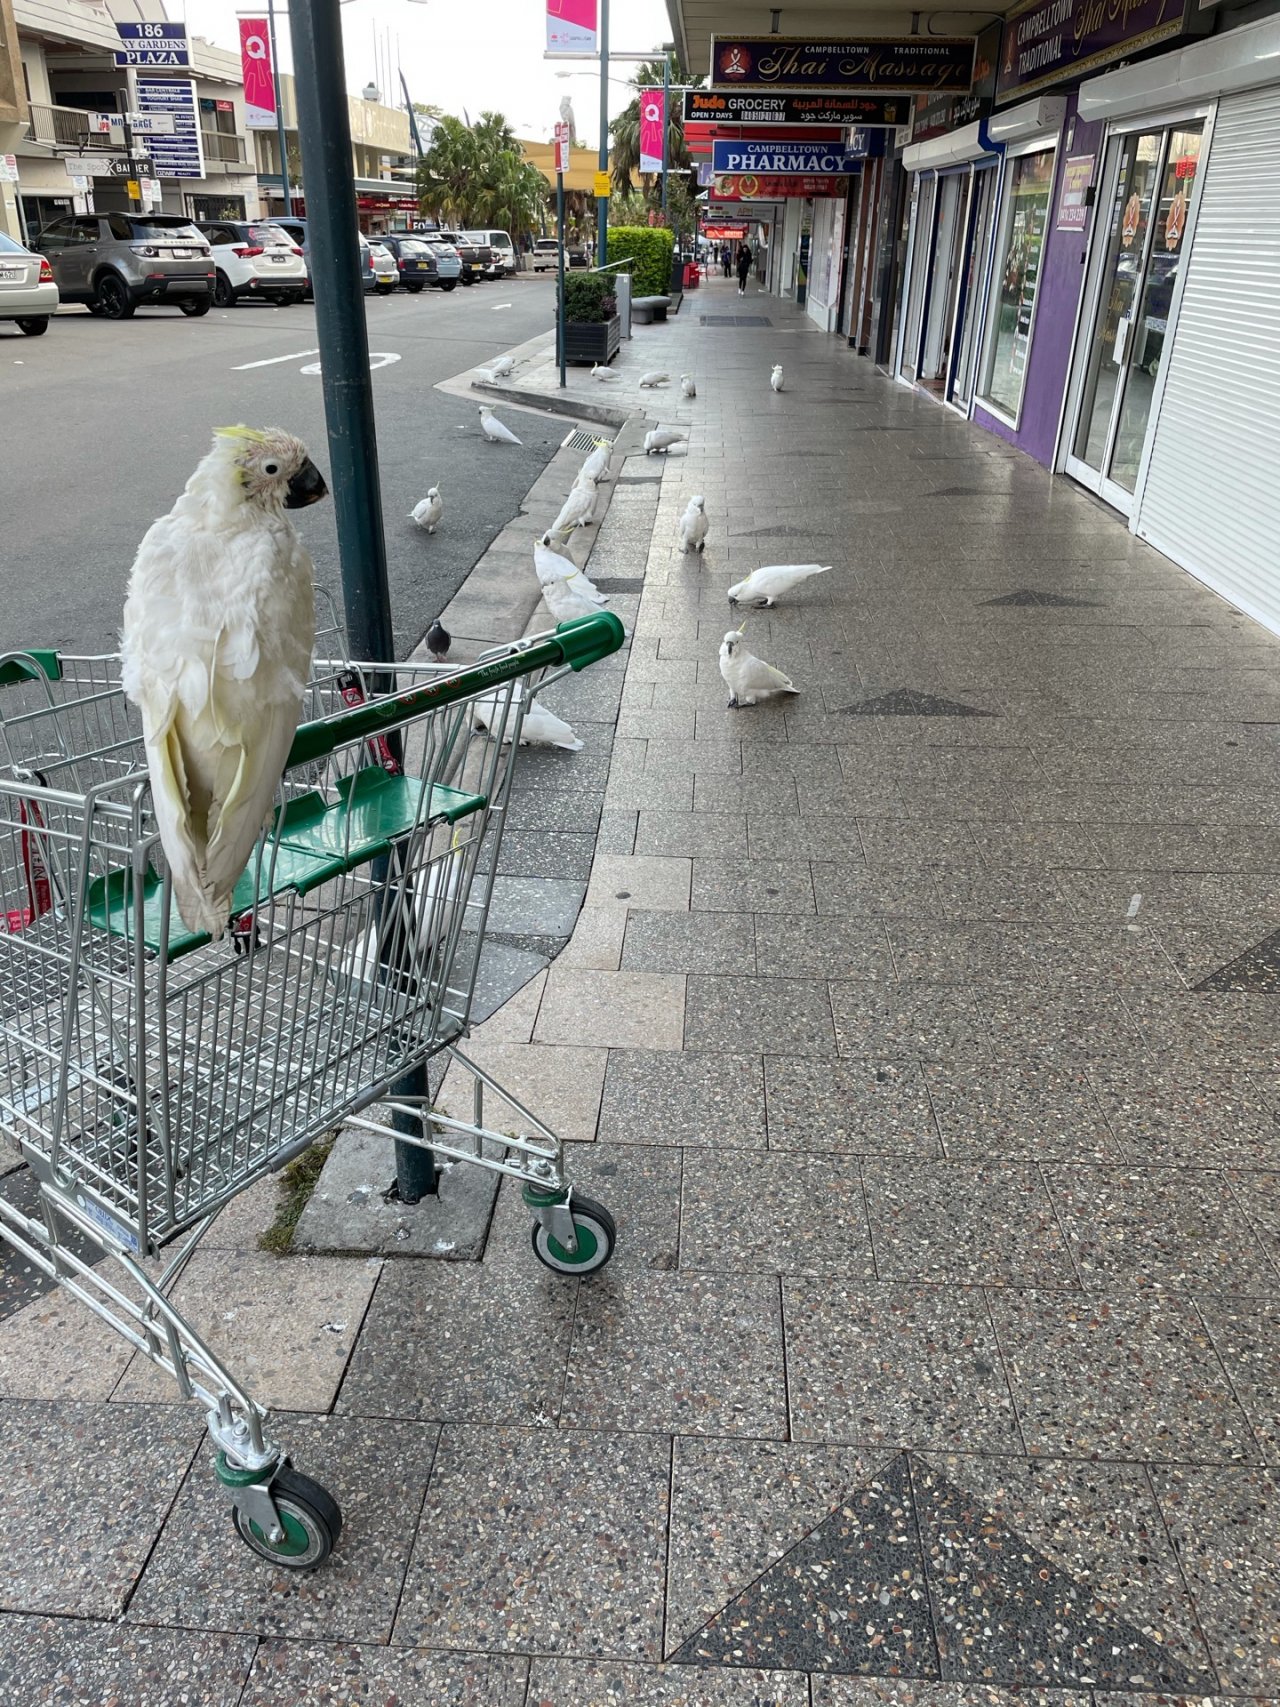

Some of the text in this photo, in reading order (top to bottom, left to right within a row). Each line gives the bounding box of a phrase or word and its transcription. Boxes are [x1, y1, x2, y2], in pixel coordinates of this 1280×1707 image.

[1017, 0, 1073, 46] CAMPBELLTOWN
[135, 23, 163, 38] 186
[138, 40, 186, 49] GARDENS
[804, 46, 950, 55] CAMPBELLTOWN TRADITIONAL
[125, 51, 180, 65] PLAZA
[1017, 34, 1062, 77] TRADITIONAL
[757, 46, 829, 82] Thai
[838, 51, 967, 87] Massage
[692, 94, 786, 110] Jude GROCERY
[709, 111, 715, 119] 7
[715, 111, 733, 119] DAYS
[111, 117, 153, 129] MOGAGE
[747, 144, 829, 154] CAMPBELLTOWN
[116, 163, 149, 173] BAER
[726, 153, 847, 171] PHARMACY
